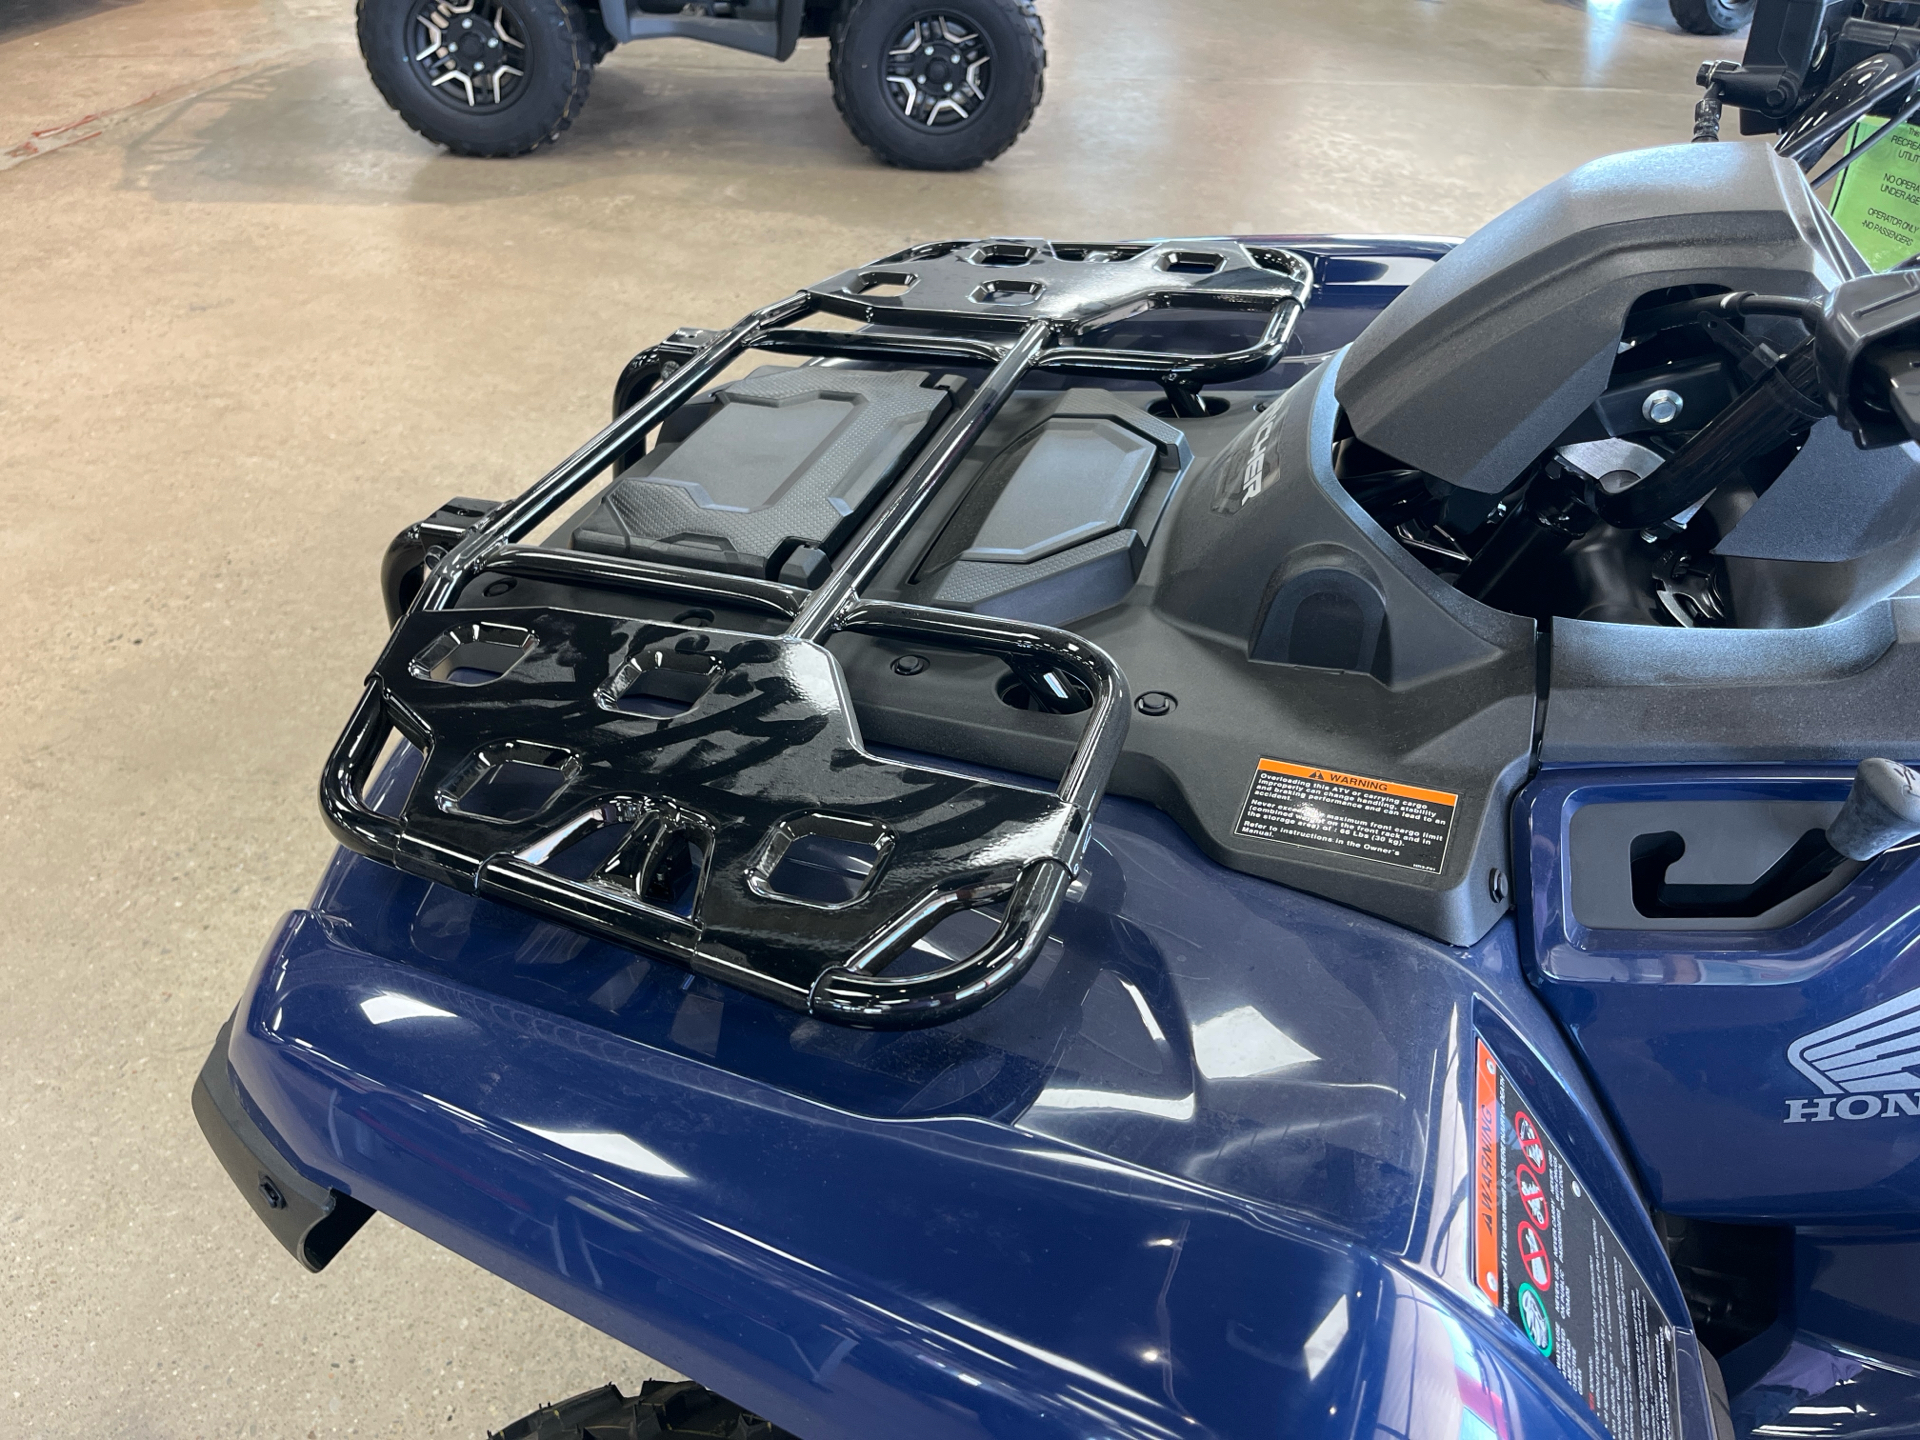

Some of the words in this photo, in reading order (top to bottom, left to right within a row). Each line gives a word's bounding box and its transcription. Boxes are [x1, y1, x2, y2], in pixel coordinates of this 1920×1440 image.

[1880, 184, 1906, 199] UNDER
[1905, 194, 1920, 206] AGE
[1883, 173, 1896, 183] NO
[1896, 178, 1920, 193] OPERA
[1868, 208, 1902, 228] OPERATOR
[1902, 222, 1920, 234] ONLY
[1873, 224, 1914, 246] PASSENGERS
[1259, 772, 1311, 787] Overloading
[1363, 792, 1400, 804] carrying
[1401, 800, 1427, 810] cargo
[1329, 773, 1388, 791] WARNING
[1273, 787, 1306, 798] braking
[1307, 794, 1362, 809] performance
[1322, 791, 1355, 802] change
[1399, 805, 1436, 817] stability
[1250, 799, 1275, 808] Never
[1326, 813, 1368, 826] maximum
[1369, 822, 1392, 831] front
[1393, 827, 1419, 837] cargo
[1422, 832, 1442, 841] limit
[1262, 813, 1295, 825] storage
[1370, 834, 1386, 842] (30
[1356, 825, 1379, 834] front
[1380, 830, 1401, 838] rack
[1243, 820, 1267, 830] Refer
[1279, 827, 1332, 842] instructions
[1362, 843, 1400, 856] Owner's
[1481, 1105, 1492, 1211] WARNING
